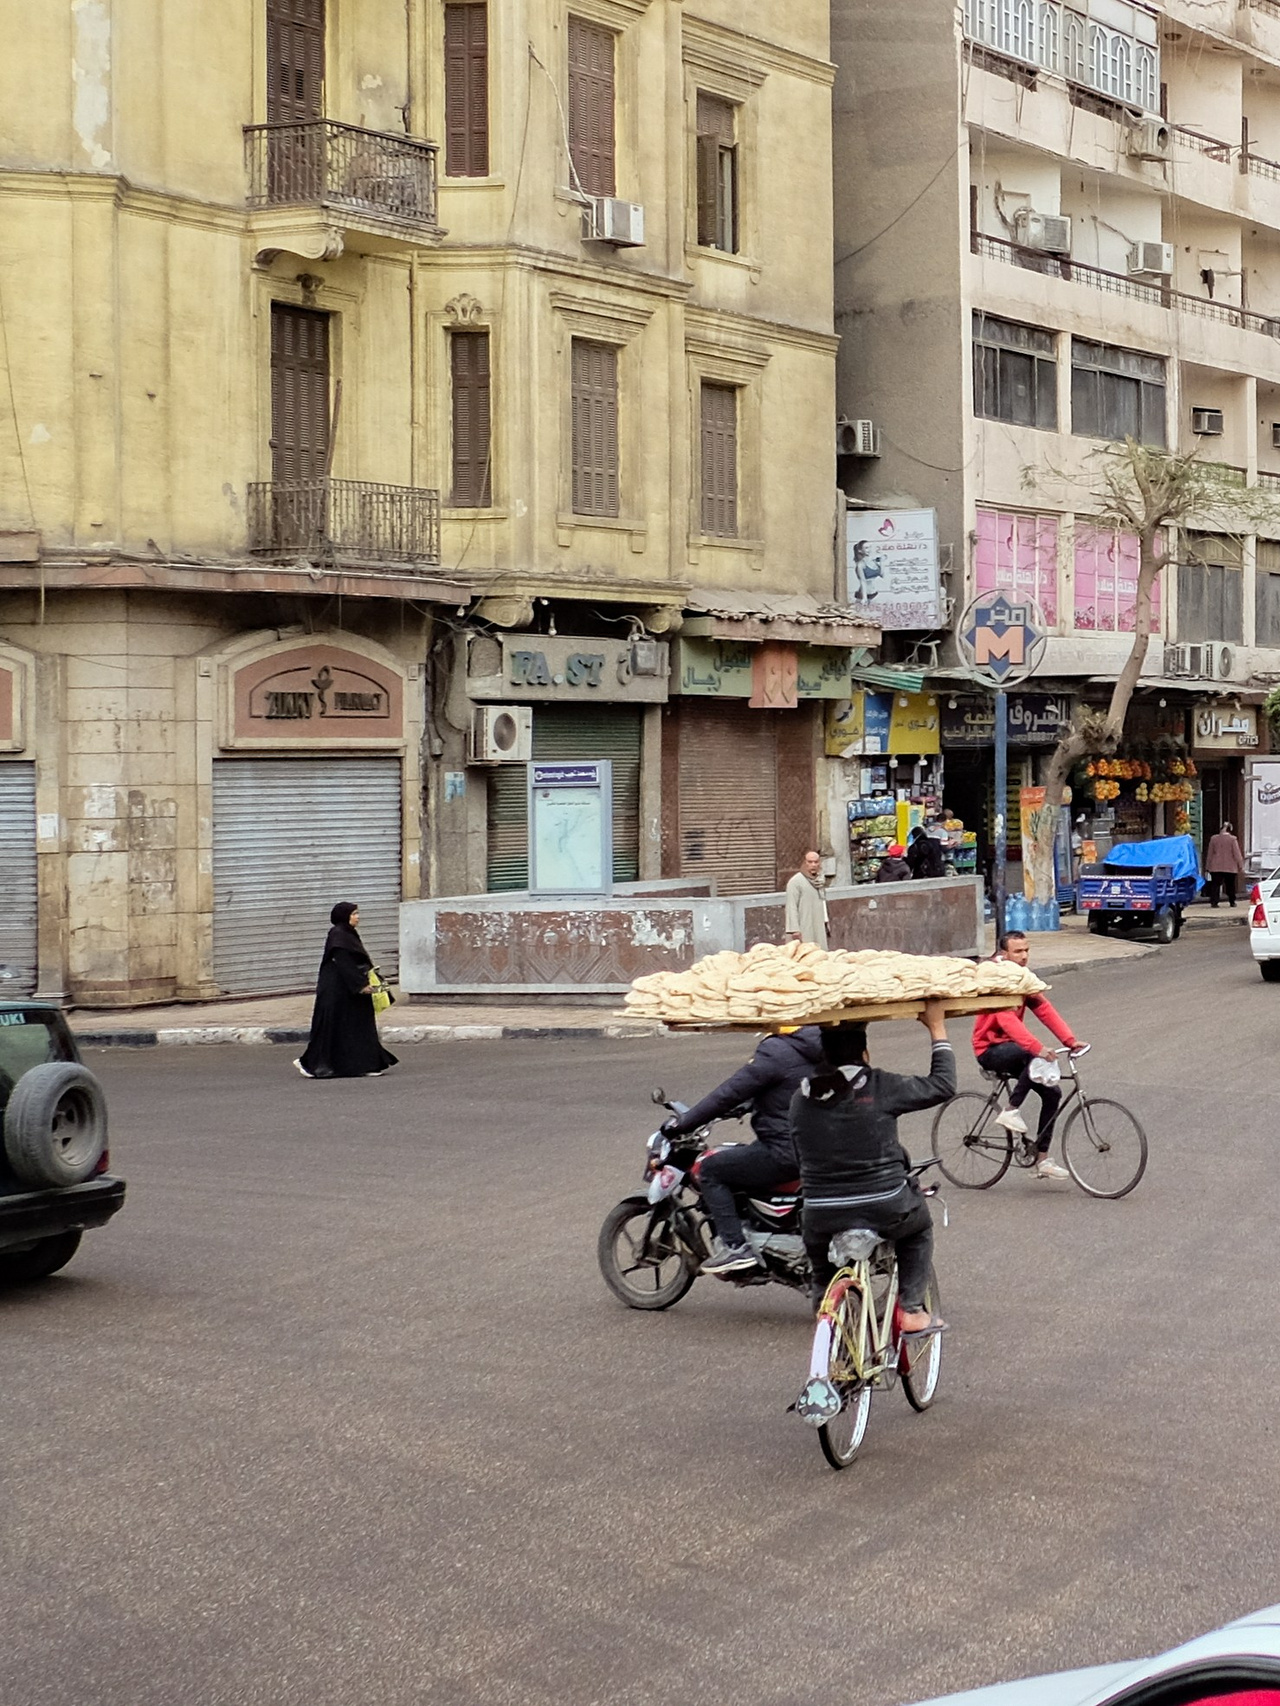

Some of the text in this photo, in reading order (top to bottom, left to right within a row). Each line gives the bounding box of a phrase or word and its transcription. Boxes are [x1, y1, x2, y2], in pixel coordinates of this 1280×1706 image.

[896, 543, 917, 551] نهلة
[975, 626, 1024, 664] M
[797, 675, 822, 697] سيدا
[1238, 735, 1259, 745] OPTICS
